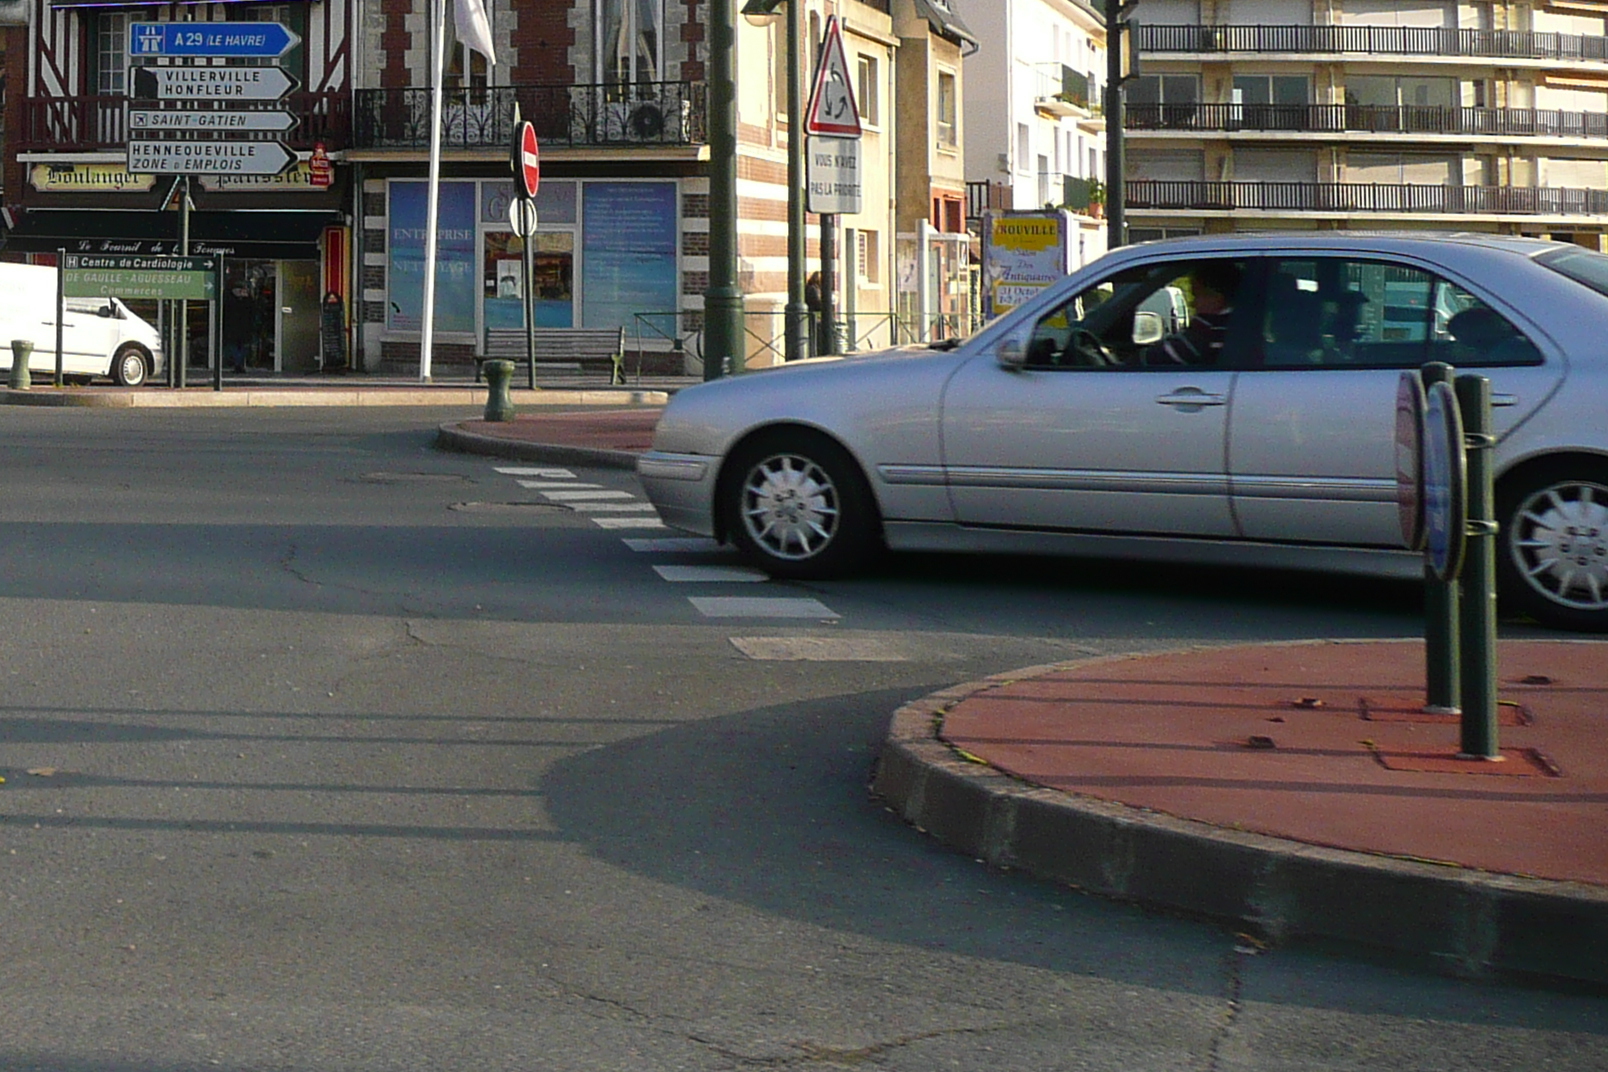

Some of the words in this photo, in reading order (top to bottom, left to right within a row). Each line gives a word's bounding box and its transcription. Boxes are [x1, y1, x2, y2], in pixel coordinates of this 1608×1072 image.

[174, 32, 184, 45] A
[186, 32, 203, 45] 29
[206, 34, 222, 47] (LE
[225, 34, 266, 47] HAVRE)
[165, 70, 261, 82] VILLERVILLE
[165, 84, 244, 96] HONFLEUR
[132, 145, 256, 157] HENNEQUEVILLE
[132, 159, 168, 170] ZONE
[184, 159, 243, 170] EMPLOIS
[815, 153, 832, 167] VOUS
[810, 181, 823, 195] PAS
[824, 182, 832, 195] LA
[394, 228, 472, 240] ENTRPRISE
[81, 256, 116, 267] Centre
[119, 257, 132, 267] de
[133, 257, 193, 271] Cardiologie
[66, 273, 78, 283] DE
[83, 273, 122, 283] GAULLE
[100, 286, 163, 296] Commerces
